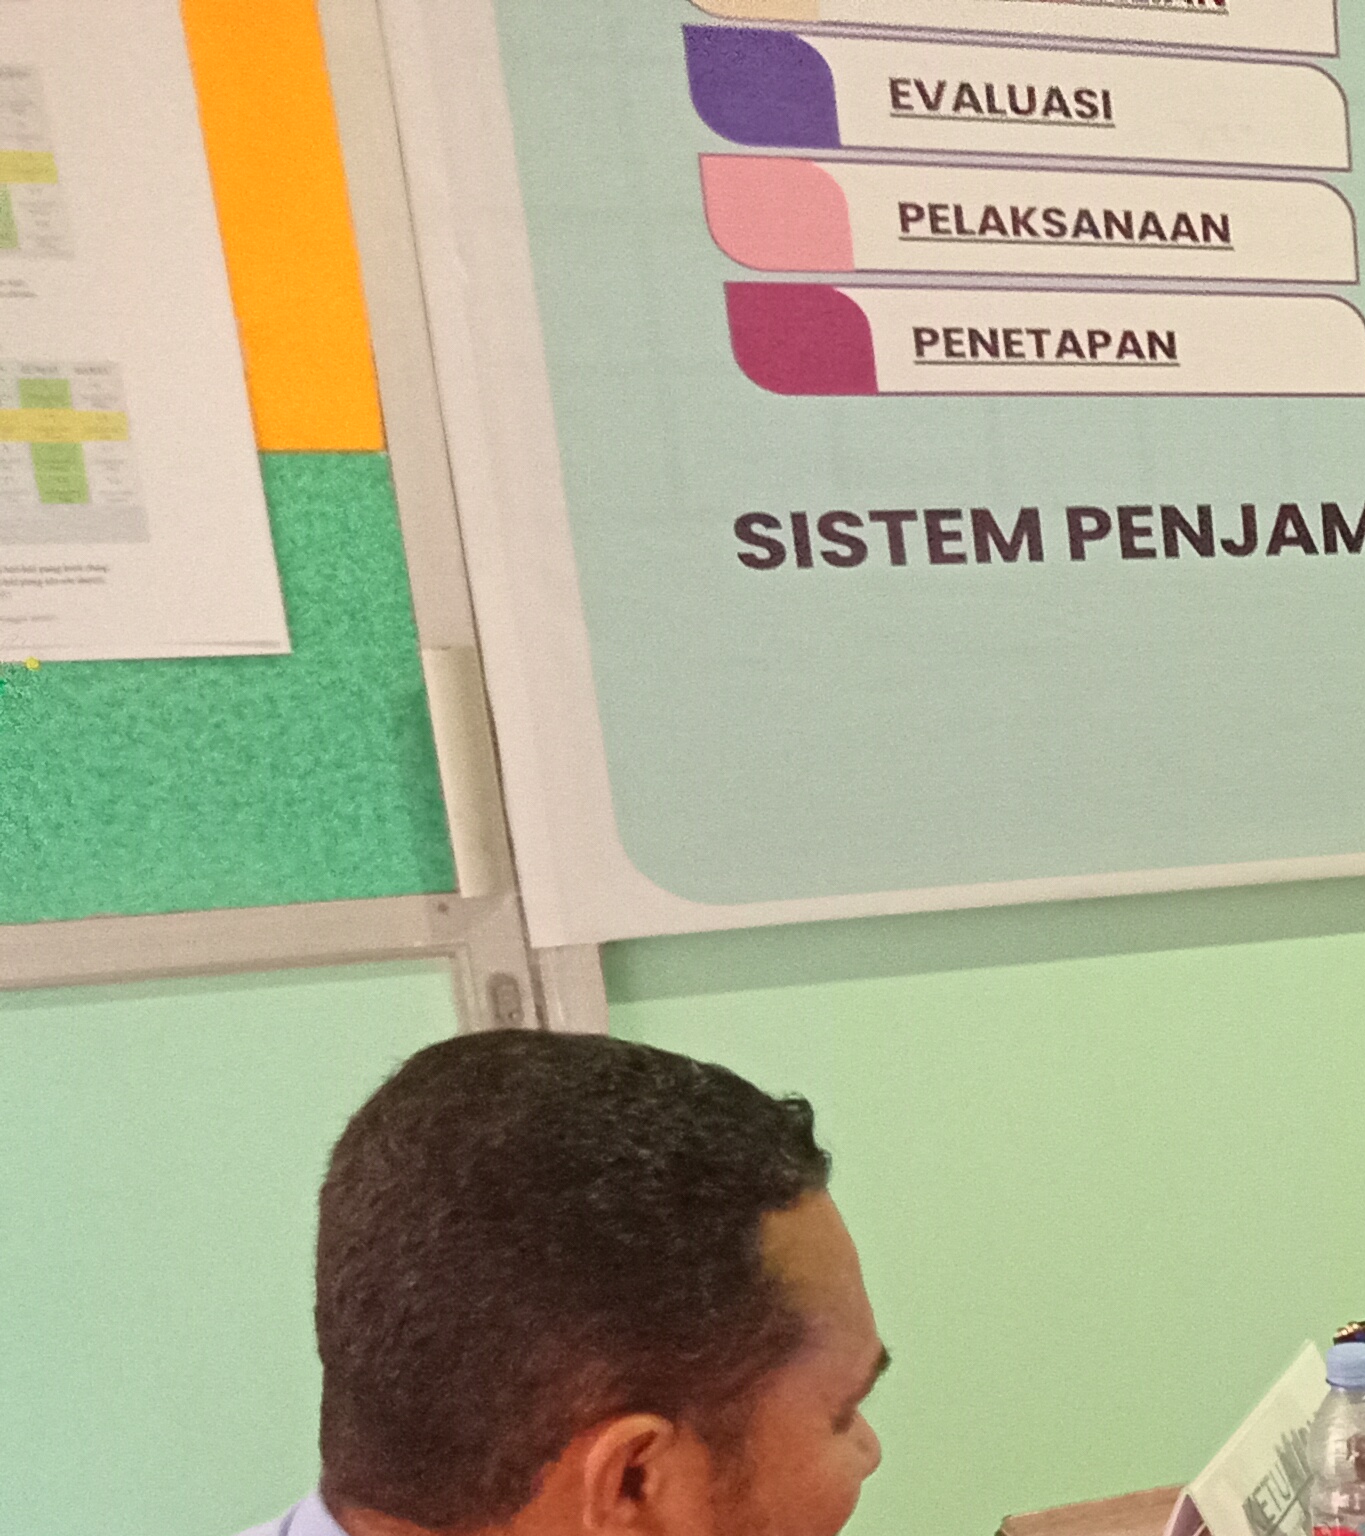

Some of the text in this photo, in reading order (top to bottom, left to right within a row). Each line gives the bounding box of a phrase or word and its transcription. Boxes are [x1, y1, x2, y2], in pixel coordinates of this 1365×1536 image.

[890, 77, 1115, 122] EVALUASI
[898, 201, 1233, 246] PELAKSANAAN
[912, 325, 1179, 364] PENETAPAN
[732, 506, 1045, 572] SISTEM
